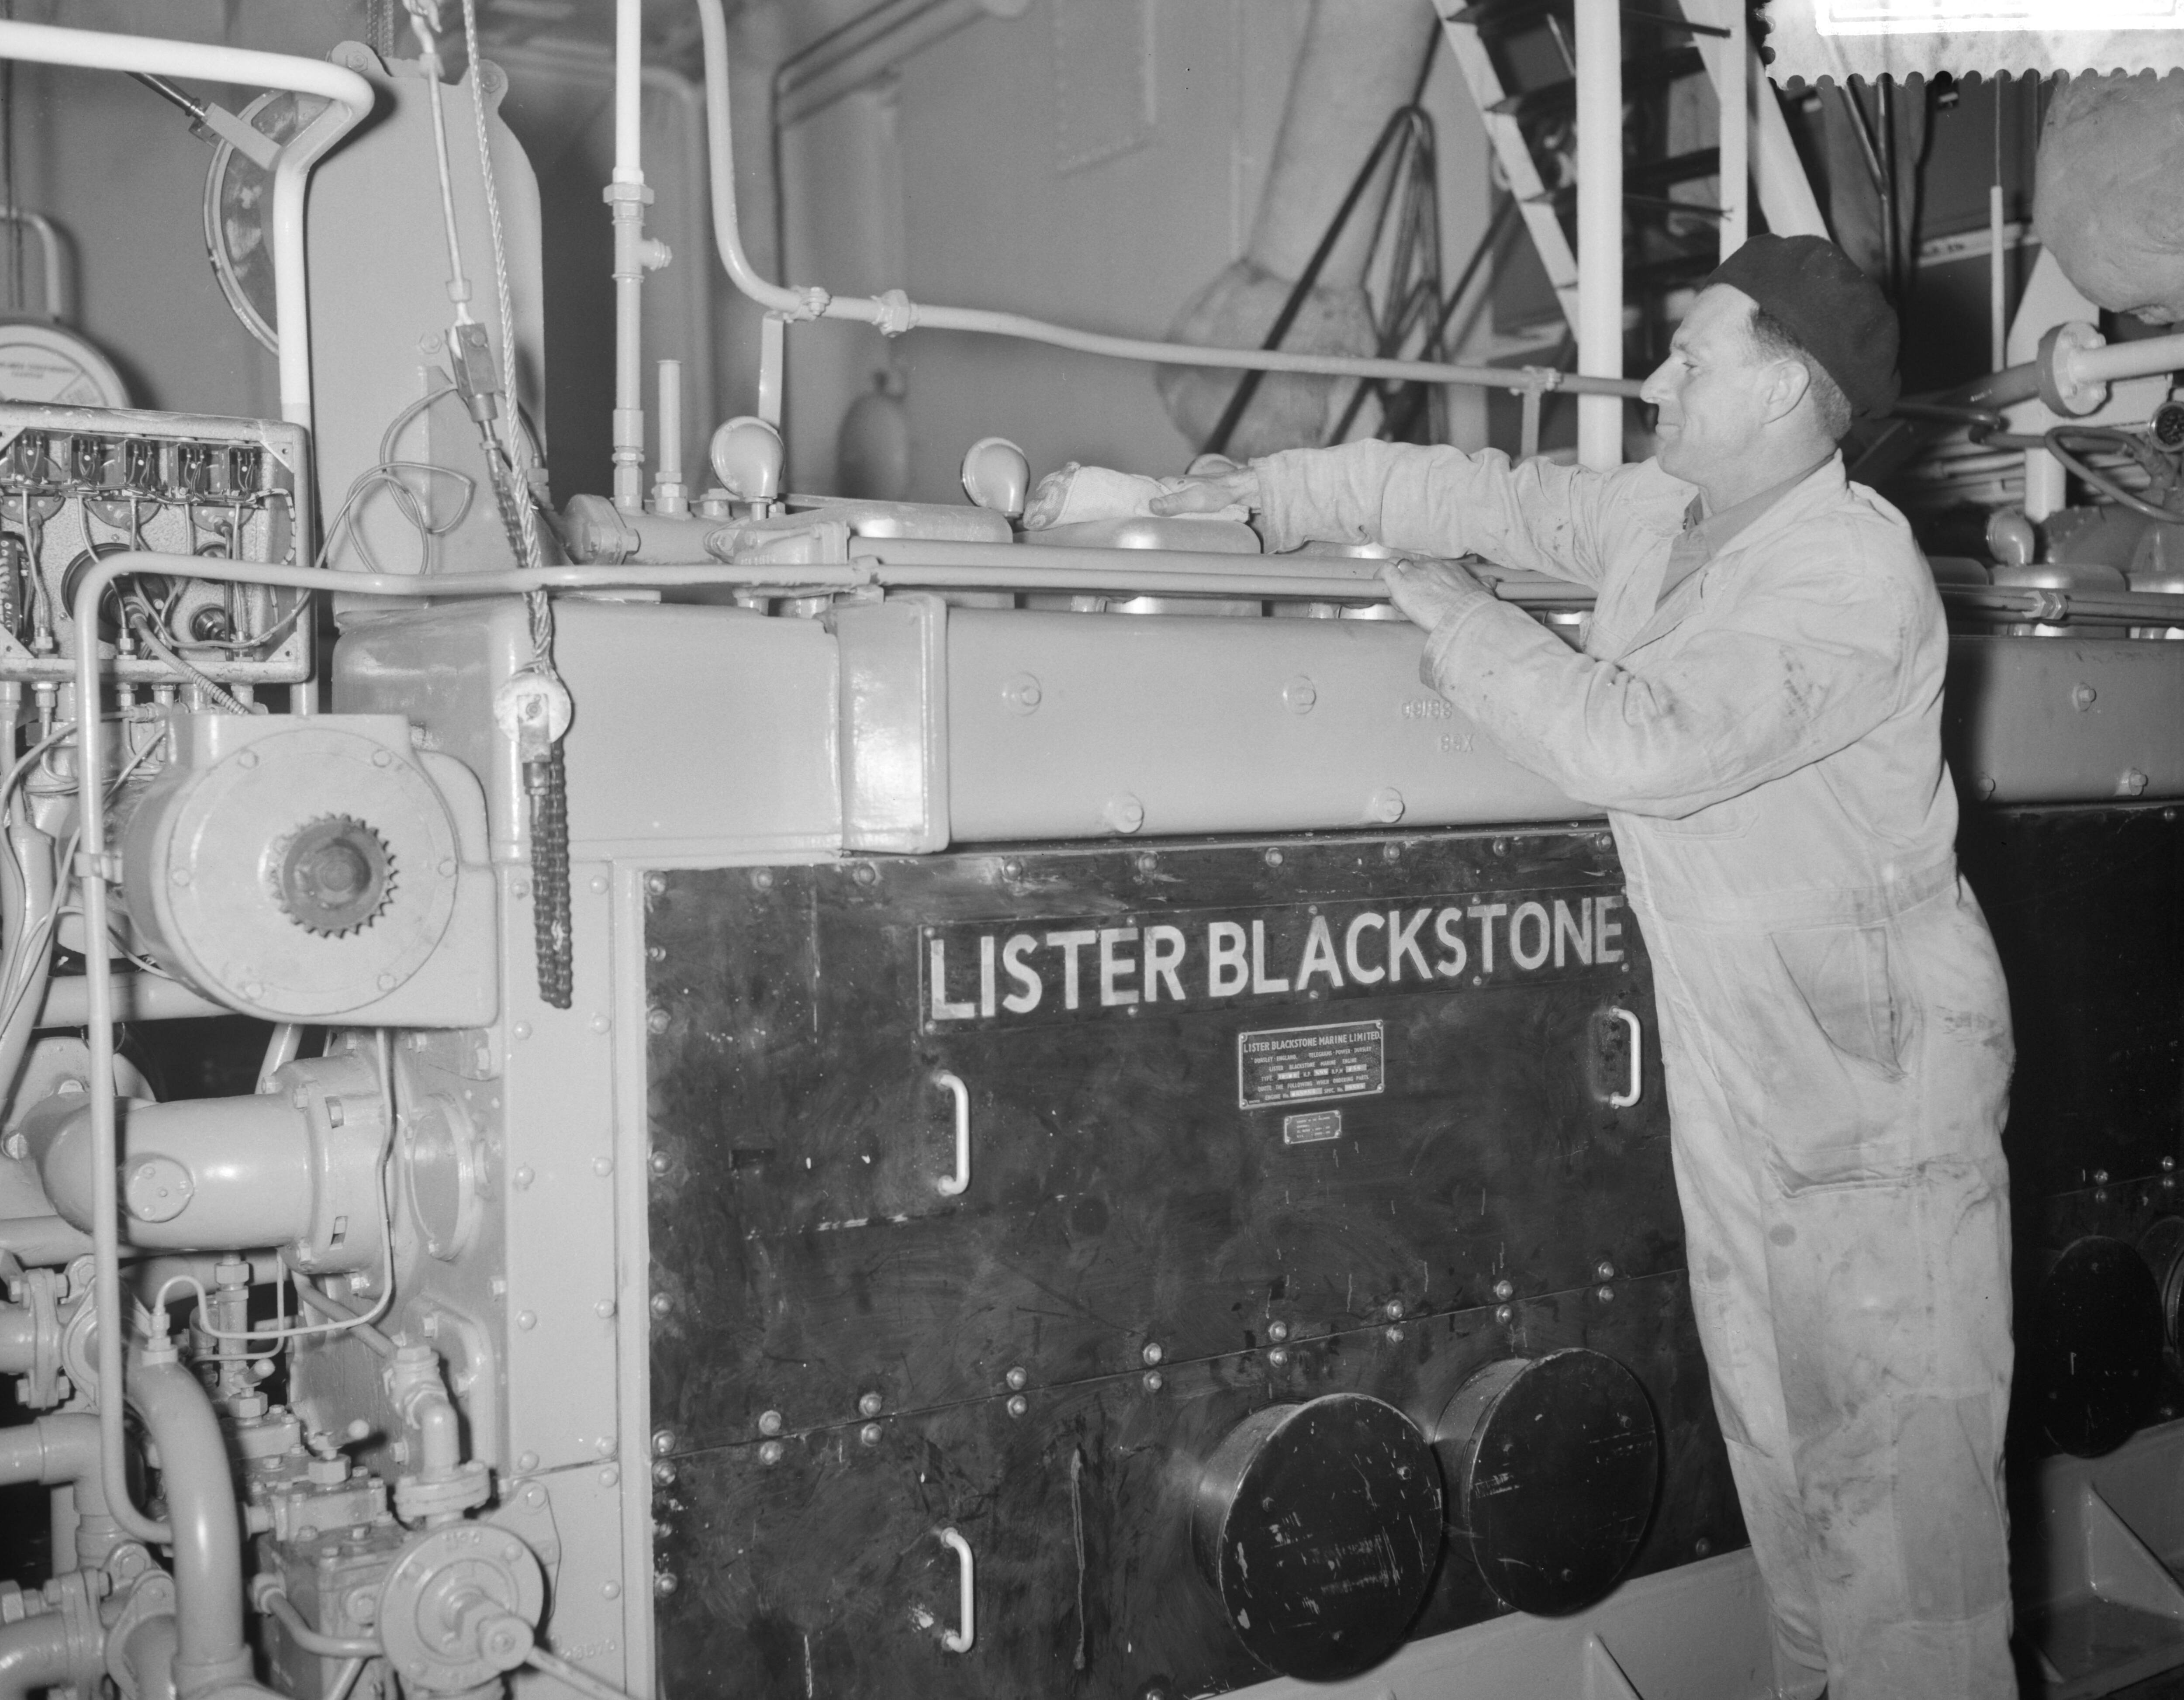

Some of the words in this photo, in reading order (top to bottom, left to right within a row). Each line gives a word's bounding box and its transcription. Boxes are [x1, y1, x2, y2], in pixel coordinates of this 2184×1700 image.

[930, 923, 1187, 1021] LISTER
[1208, 895, 1625, 999] BLACKSTONE
[1244, 1042, 1269, 1053] LISTER
[1272, 1037, 1317, 1050] BLACKSTONE
[1319, 1033, 1347, 1045] MARINE
